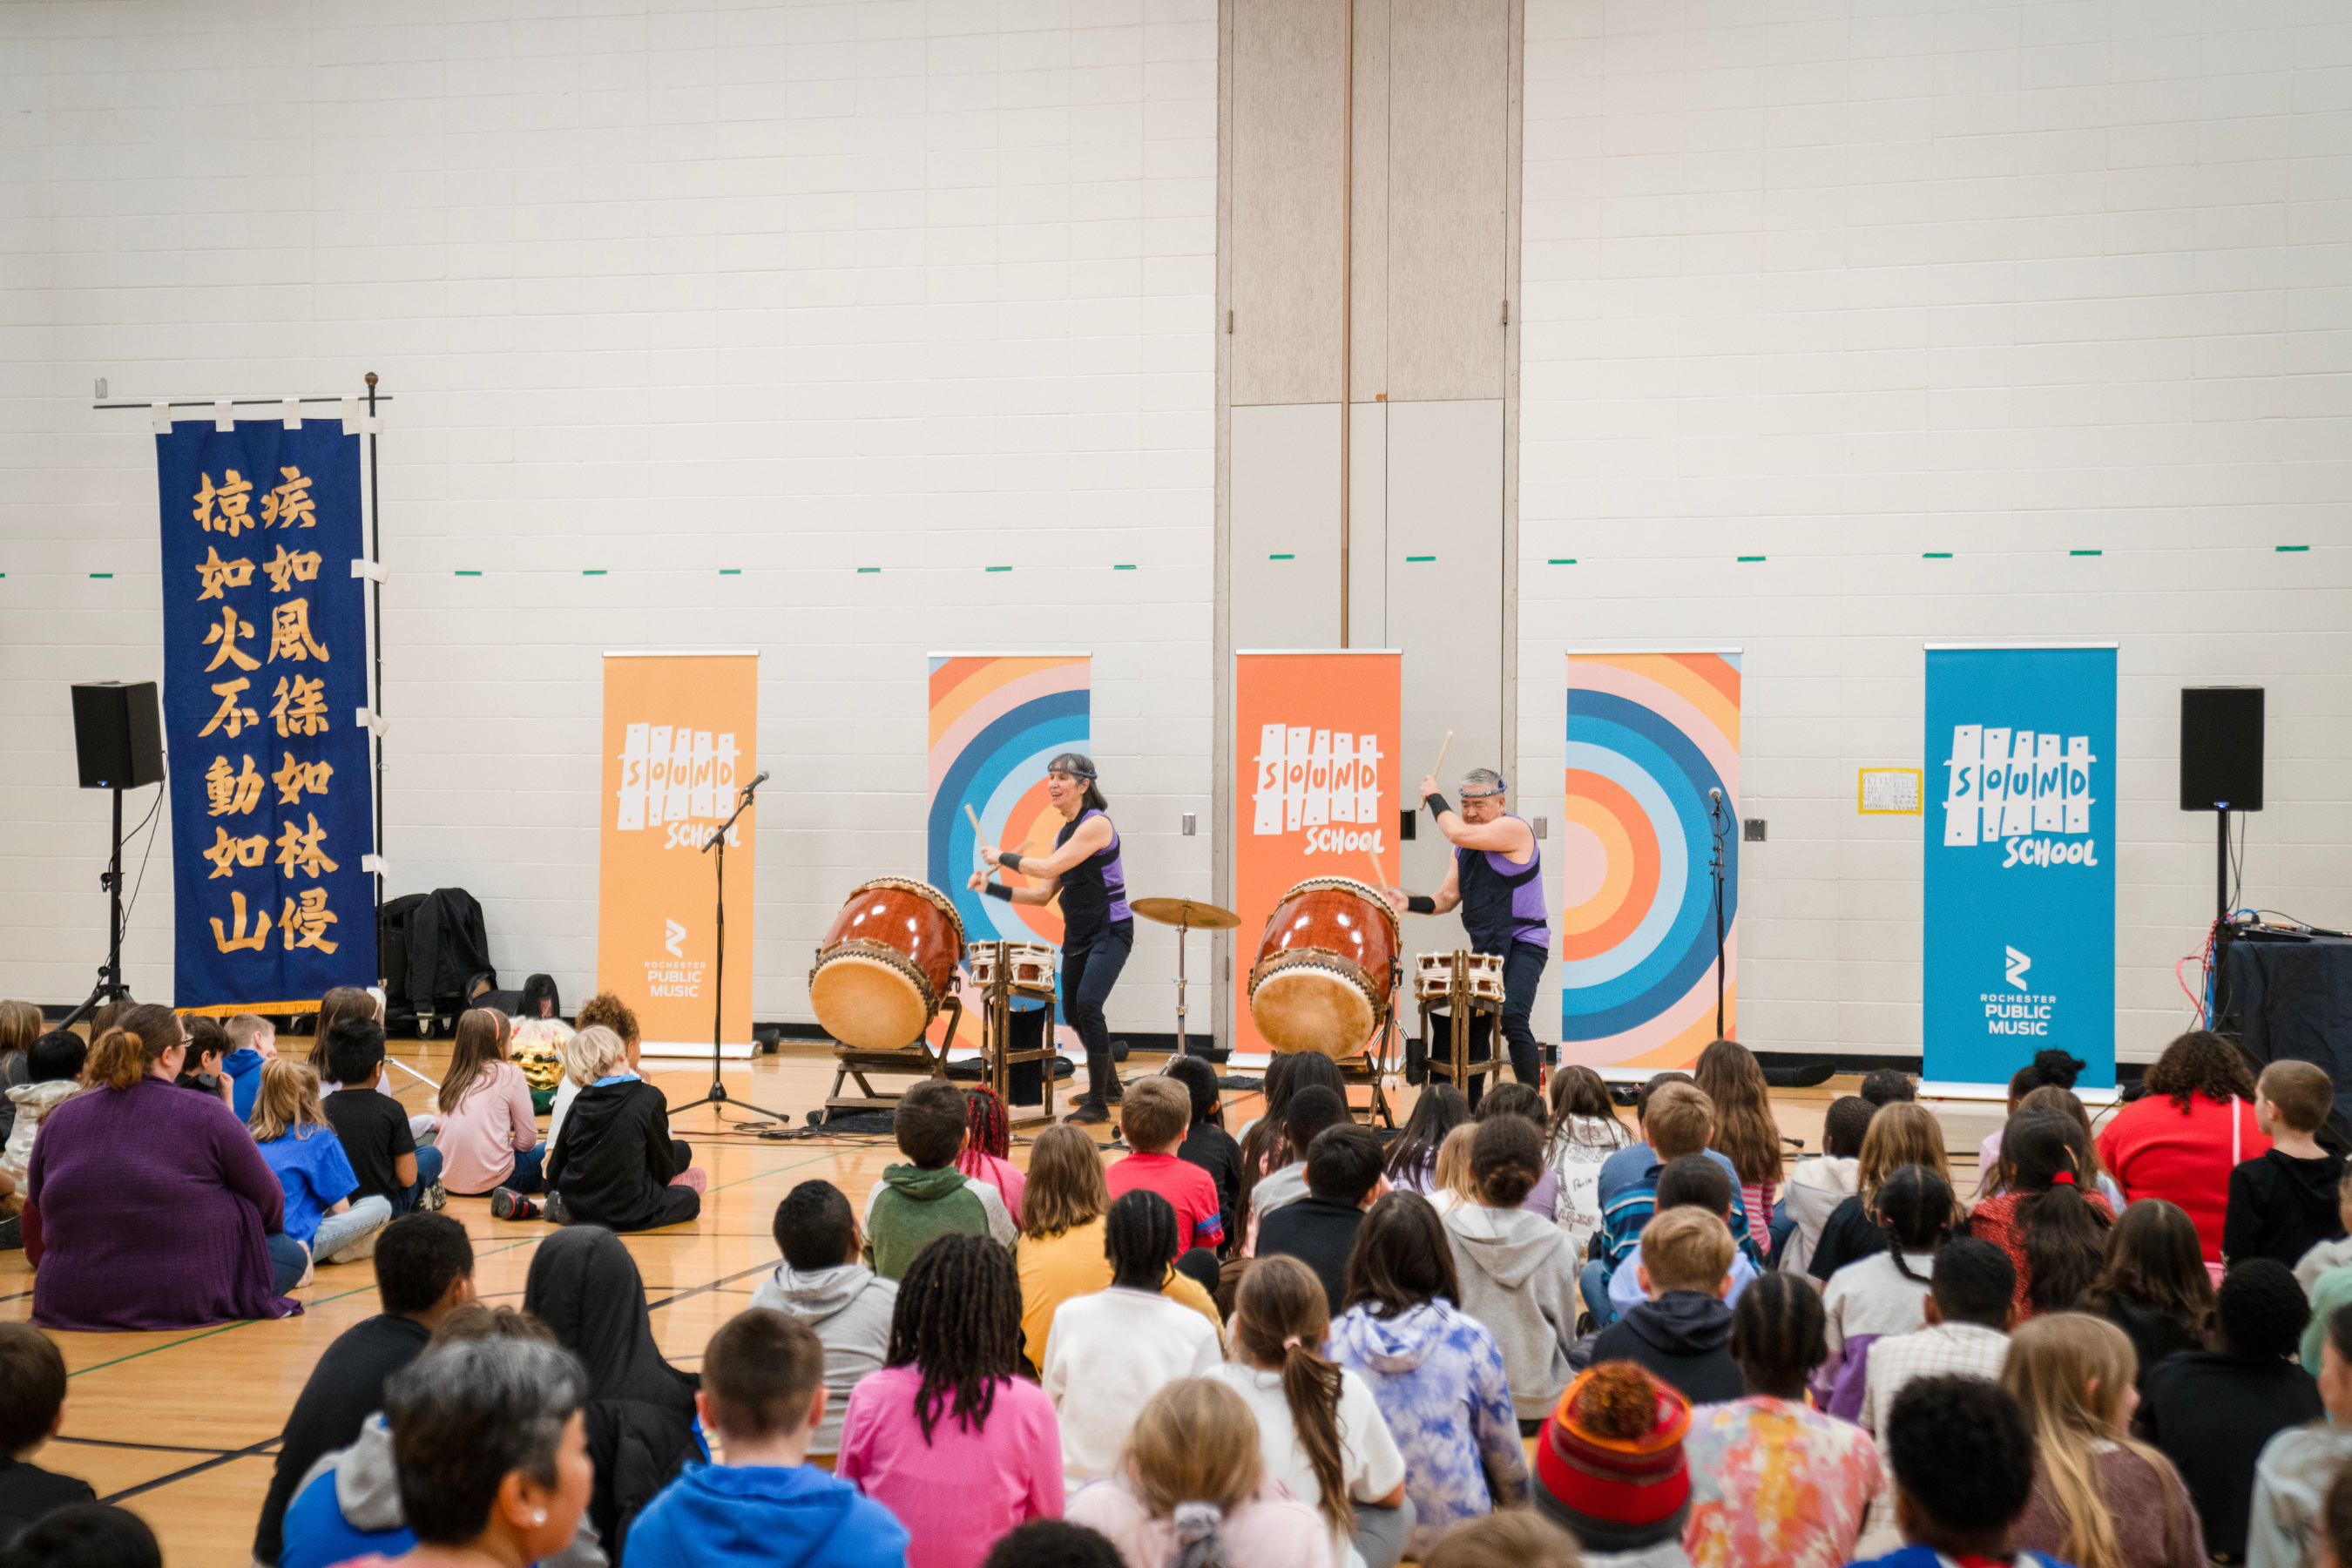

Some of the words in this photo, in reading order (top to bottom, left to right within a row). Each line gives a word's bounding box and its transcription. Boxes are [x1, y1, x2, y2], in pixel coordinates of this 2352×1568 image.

[626, 760, 733, 787] SOUND
[1262, 761, 1375, 790] SOUND
[1956, 766, 2086, 797] SOUND
[1303, 826, 1385, 855] SCHOOL
[2003, 836, 2099, 868] SCHOOL
[644, 961, 706, 970] ROCHESTER
[647, 970, 702, 983] PUBLIC
[650, 984, 699, 997] MUSIC
[1980, 994, 2057, 1004] ROCHESTER
[1984, 1004, 2051, 1020] PUBLIC
[1988, 1020, 2048, 1036] MUSIC
